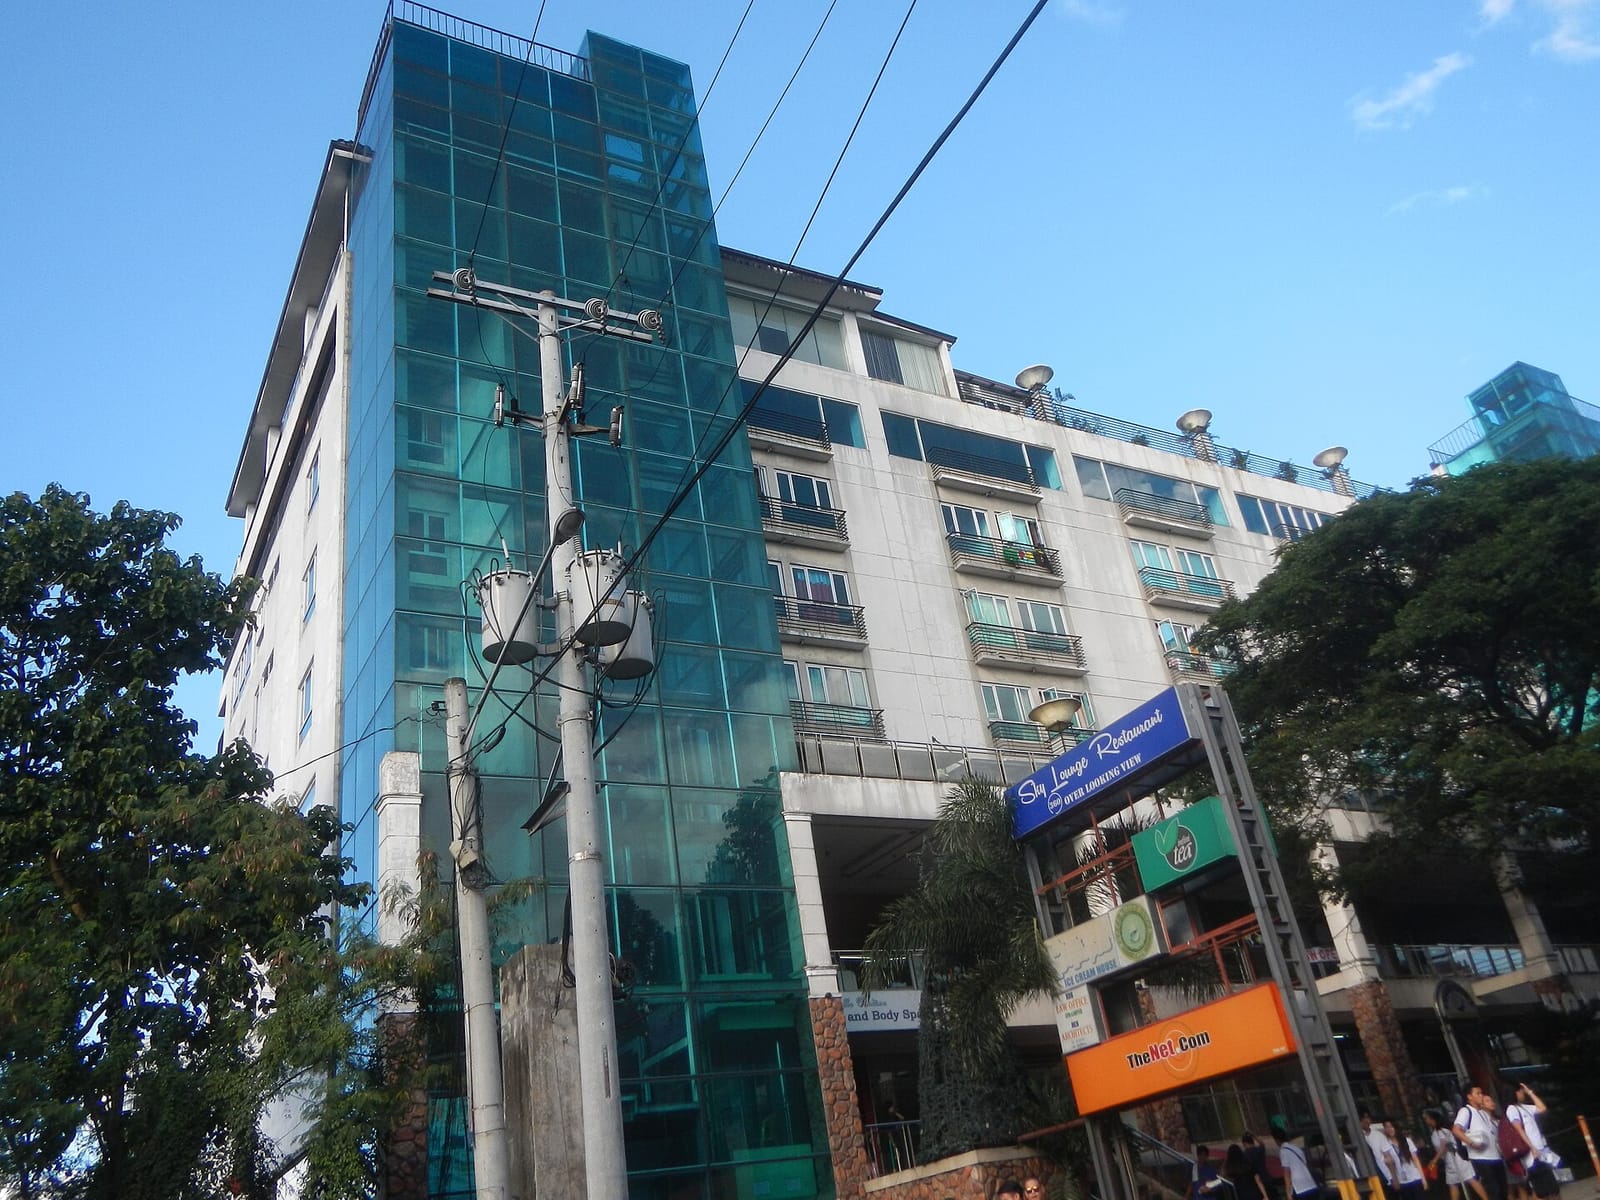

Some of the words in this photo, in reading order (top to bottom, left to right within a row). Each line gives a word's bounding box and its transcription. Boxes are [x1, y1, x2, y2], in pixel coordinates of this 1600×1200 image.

[1018, 779, 1047, 805] Sky
[1051, 756, 1088, 793] Lounge
[1088, 708, 1163, 761] Restaurant
[1064, 787, 1085, 806] OVER
[1085, 766, 1120, 793] LOOKING
[1120, 752, 1143, 773] VIEW
[1173, 841, 1193, 865] tea
[1064, 977, 1075, 988] ICE
[1075, 967, 1097, 984] CREAM
[1097, 959, 1118, 977] HOUSE
[847, 1010, 869, 1021] and
[872, 1009, 900, 1022] Body
